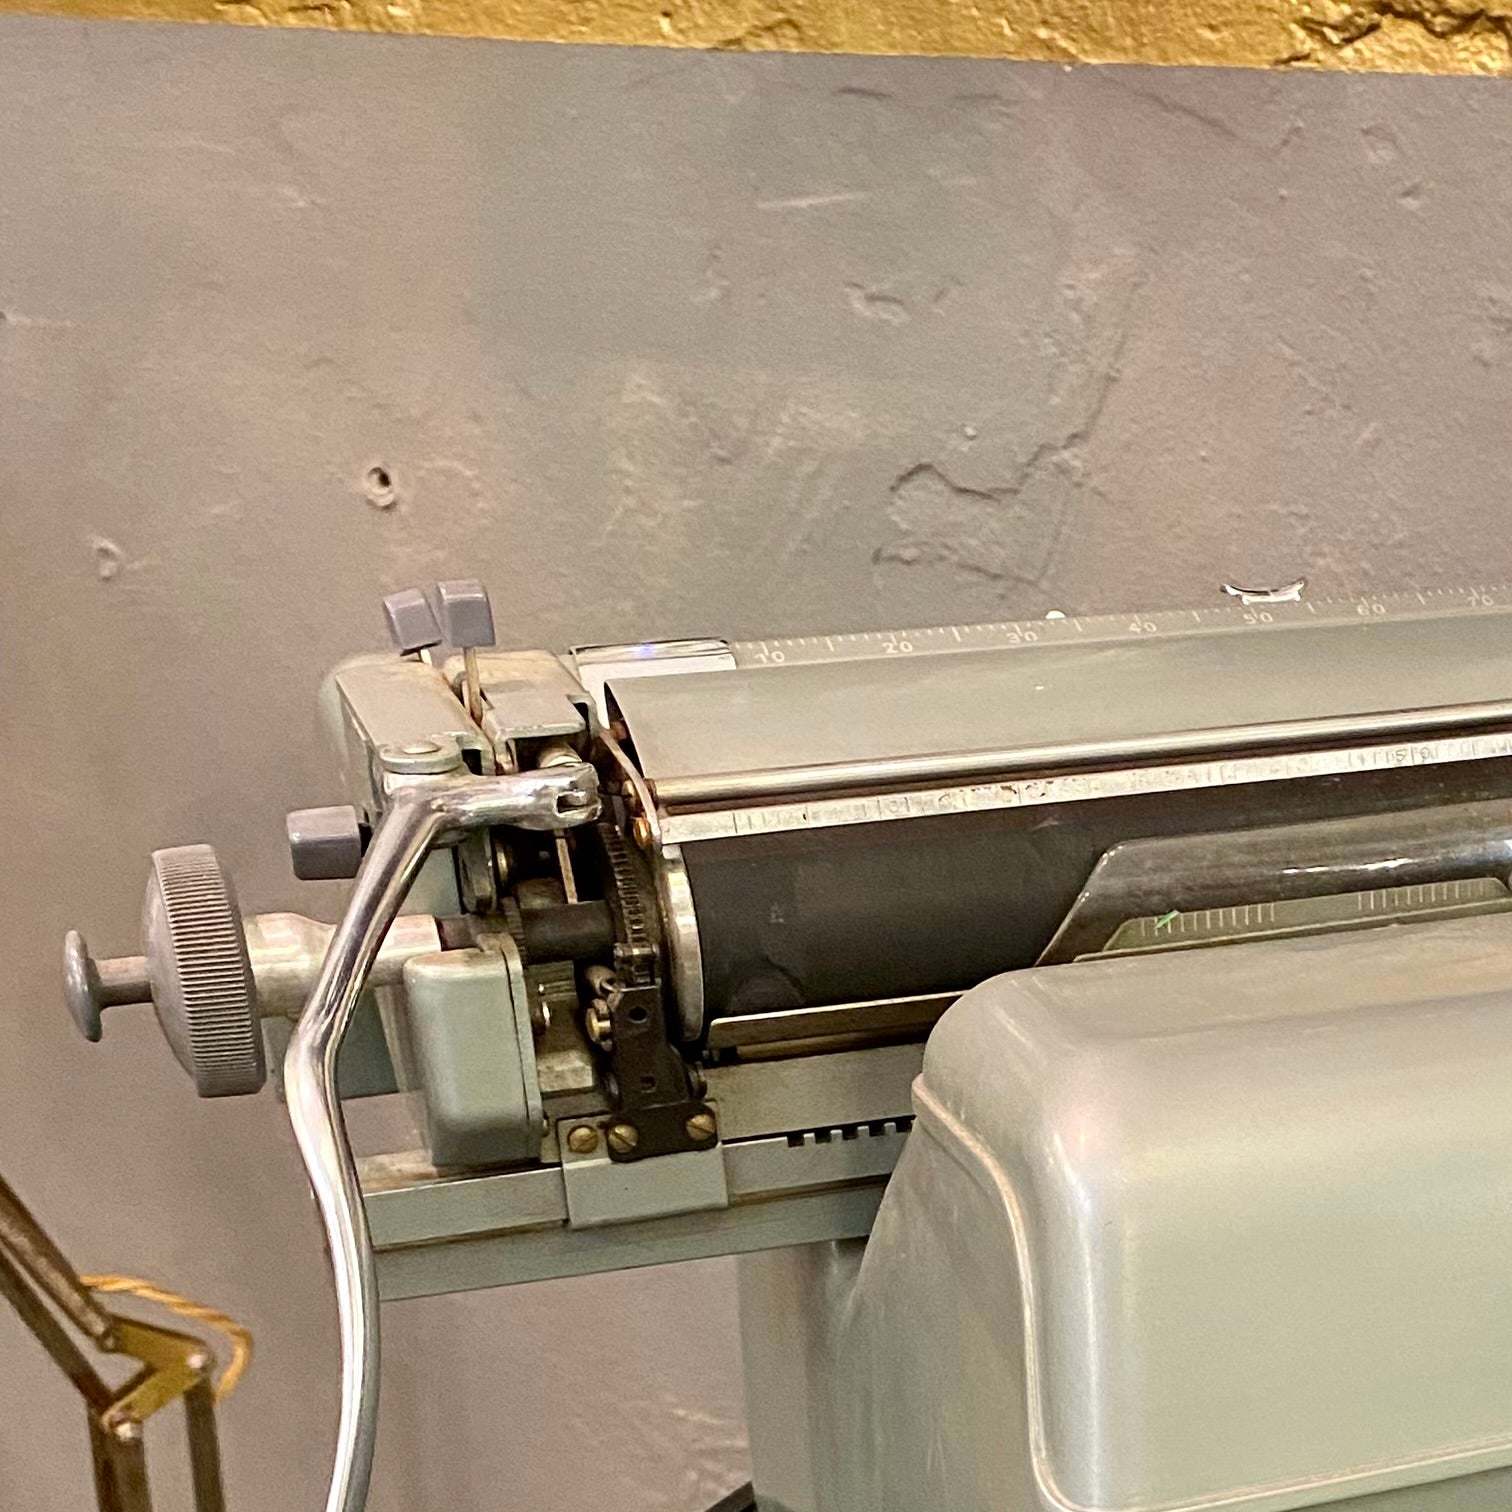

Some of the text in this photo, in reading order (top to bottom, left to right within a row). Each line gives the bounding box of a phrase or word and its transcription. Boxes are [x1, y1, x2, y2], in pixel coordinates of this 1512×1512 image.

[1466, 593, 1495, 608] 70
[1356, 602, 1387, 616] 60
[1243, 611, 1274, 625] 50
[1128, 621, 1158, 635] 40
[1006, 630, 1039, 645] 30
[881, 640, 914, 654] 20
[753, 650, 785, 665] 10
